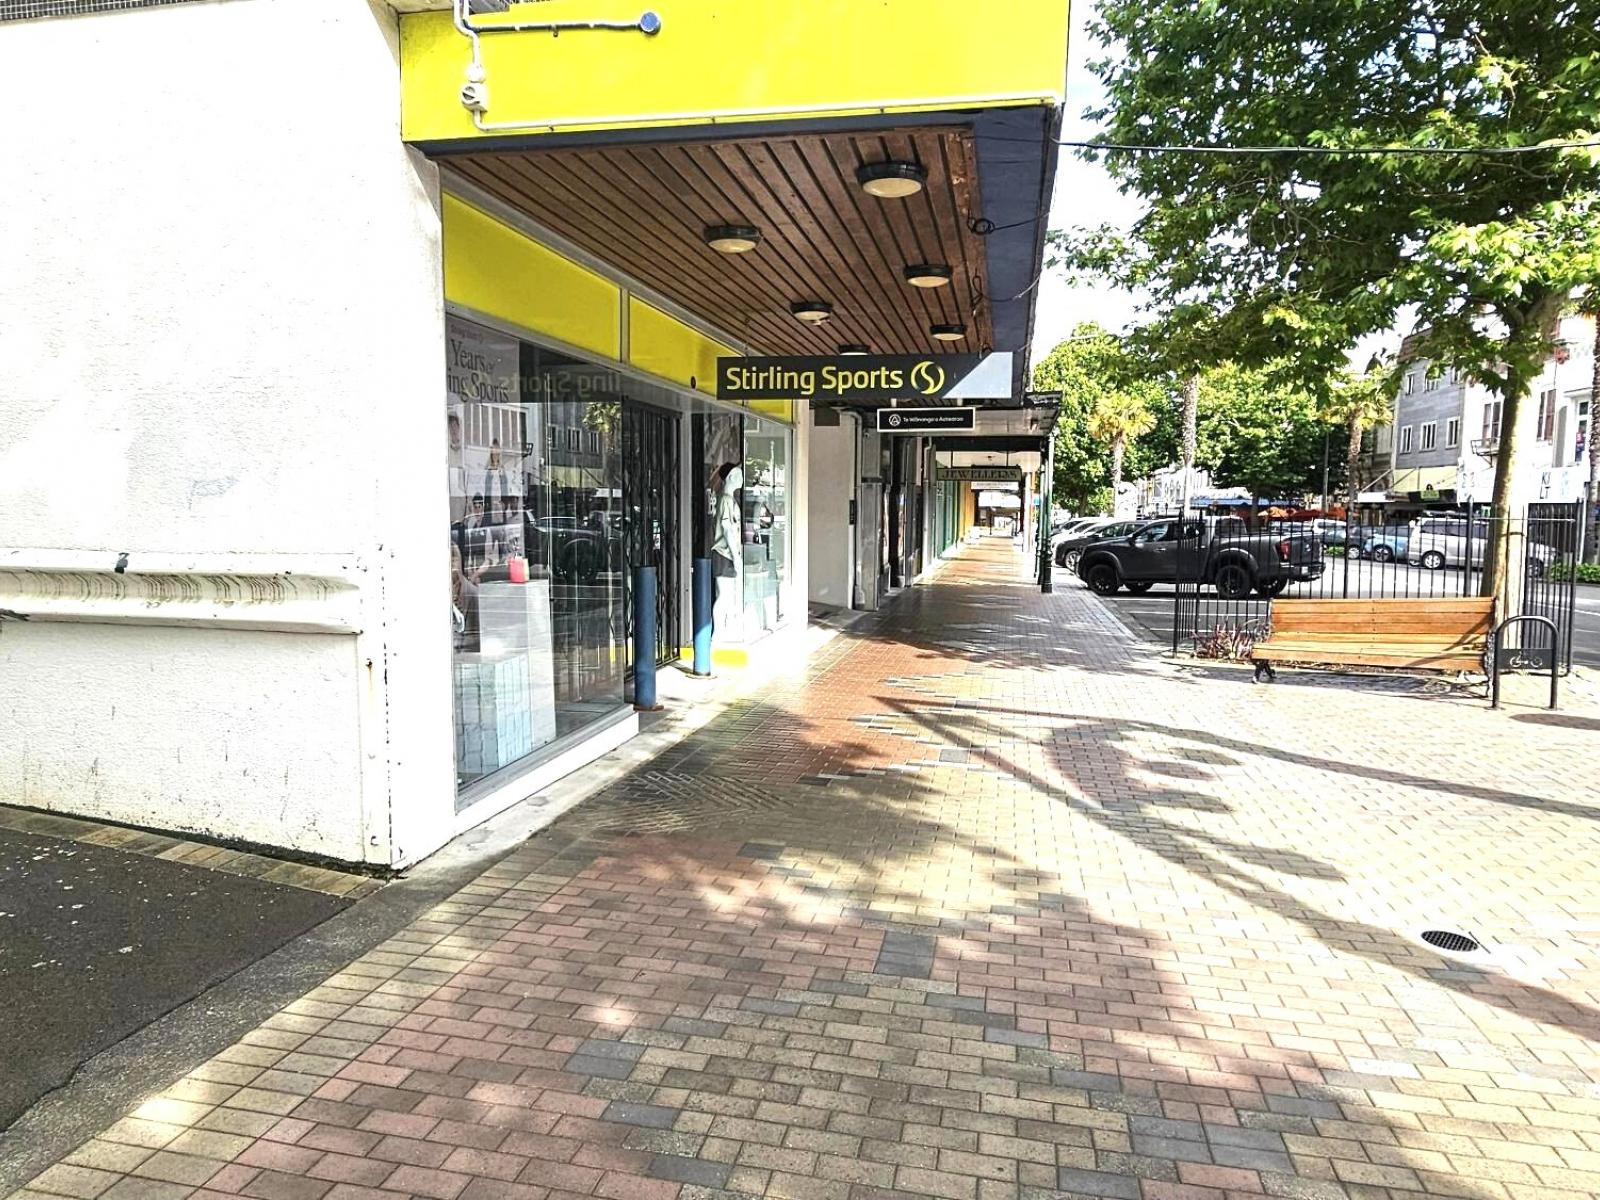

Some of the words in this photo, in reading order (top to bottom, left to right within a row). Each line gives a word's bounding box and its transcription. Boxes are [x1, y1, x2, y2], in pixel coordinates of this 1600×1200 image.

[451, 339, 486, 373] Years
[470, 372, 510, 404] Sports
[726, 366, 815, 395] Stirling
[821, 365, 904, 395] Sports
[942, 468, 1017, 480] JEWELLERS
